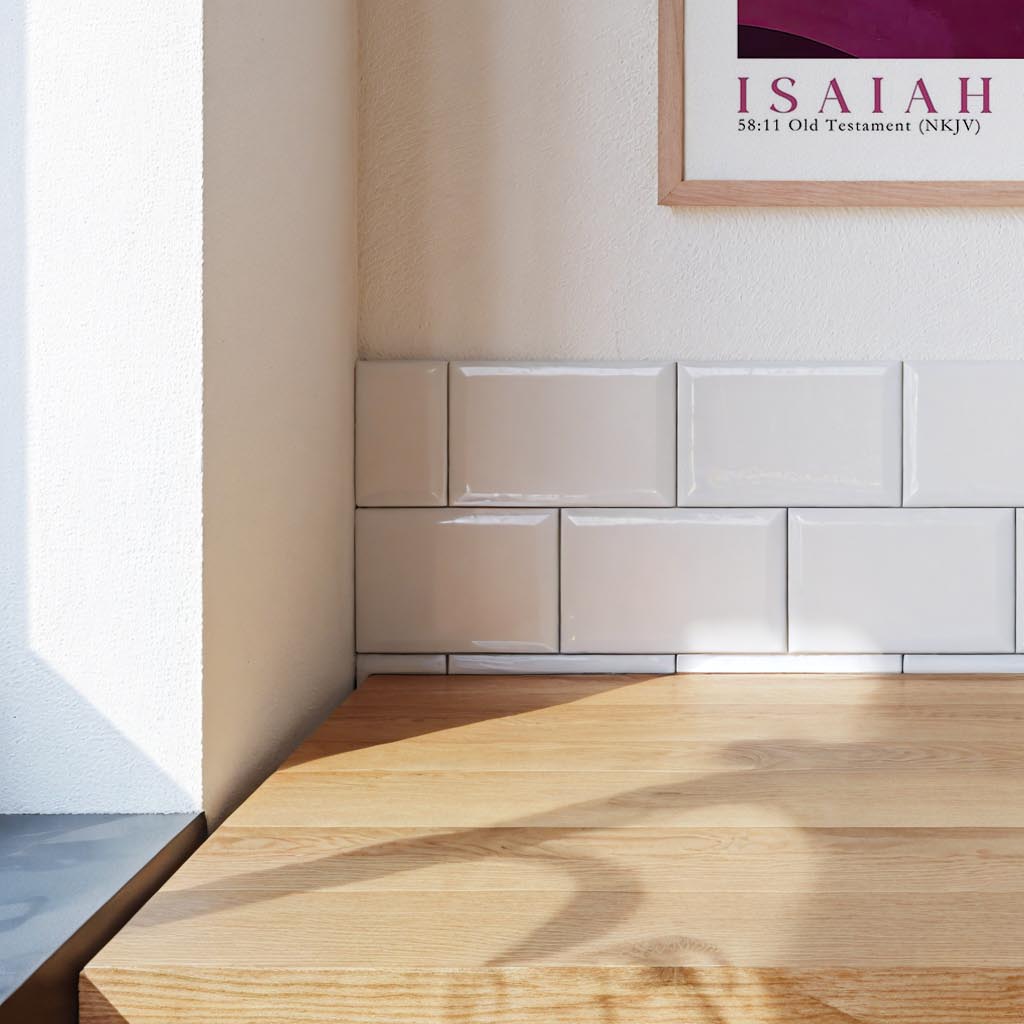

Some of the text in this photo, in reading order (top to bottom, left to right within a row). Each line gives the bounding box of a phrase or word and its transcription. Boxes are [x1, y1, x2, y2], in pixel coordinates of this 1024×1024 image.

[738, 76, 993, 114] ISAIAH
[737, 118, 981, 136] 58:11 Old Testament (NKJV)
